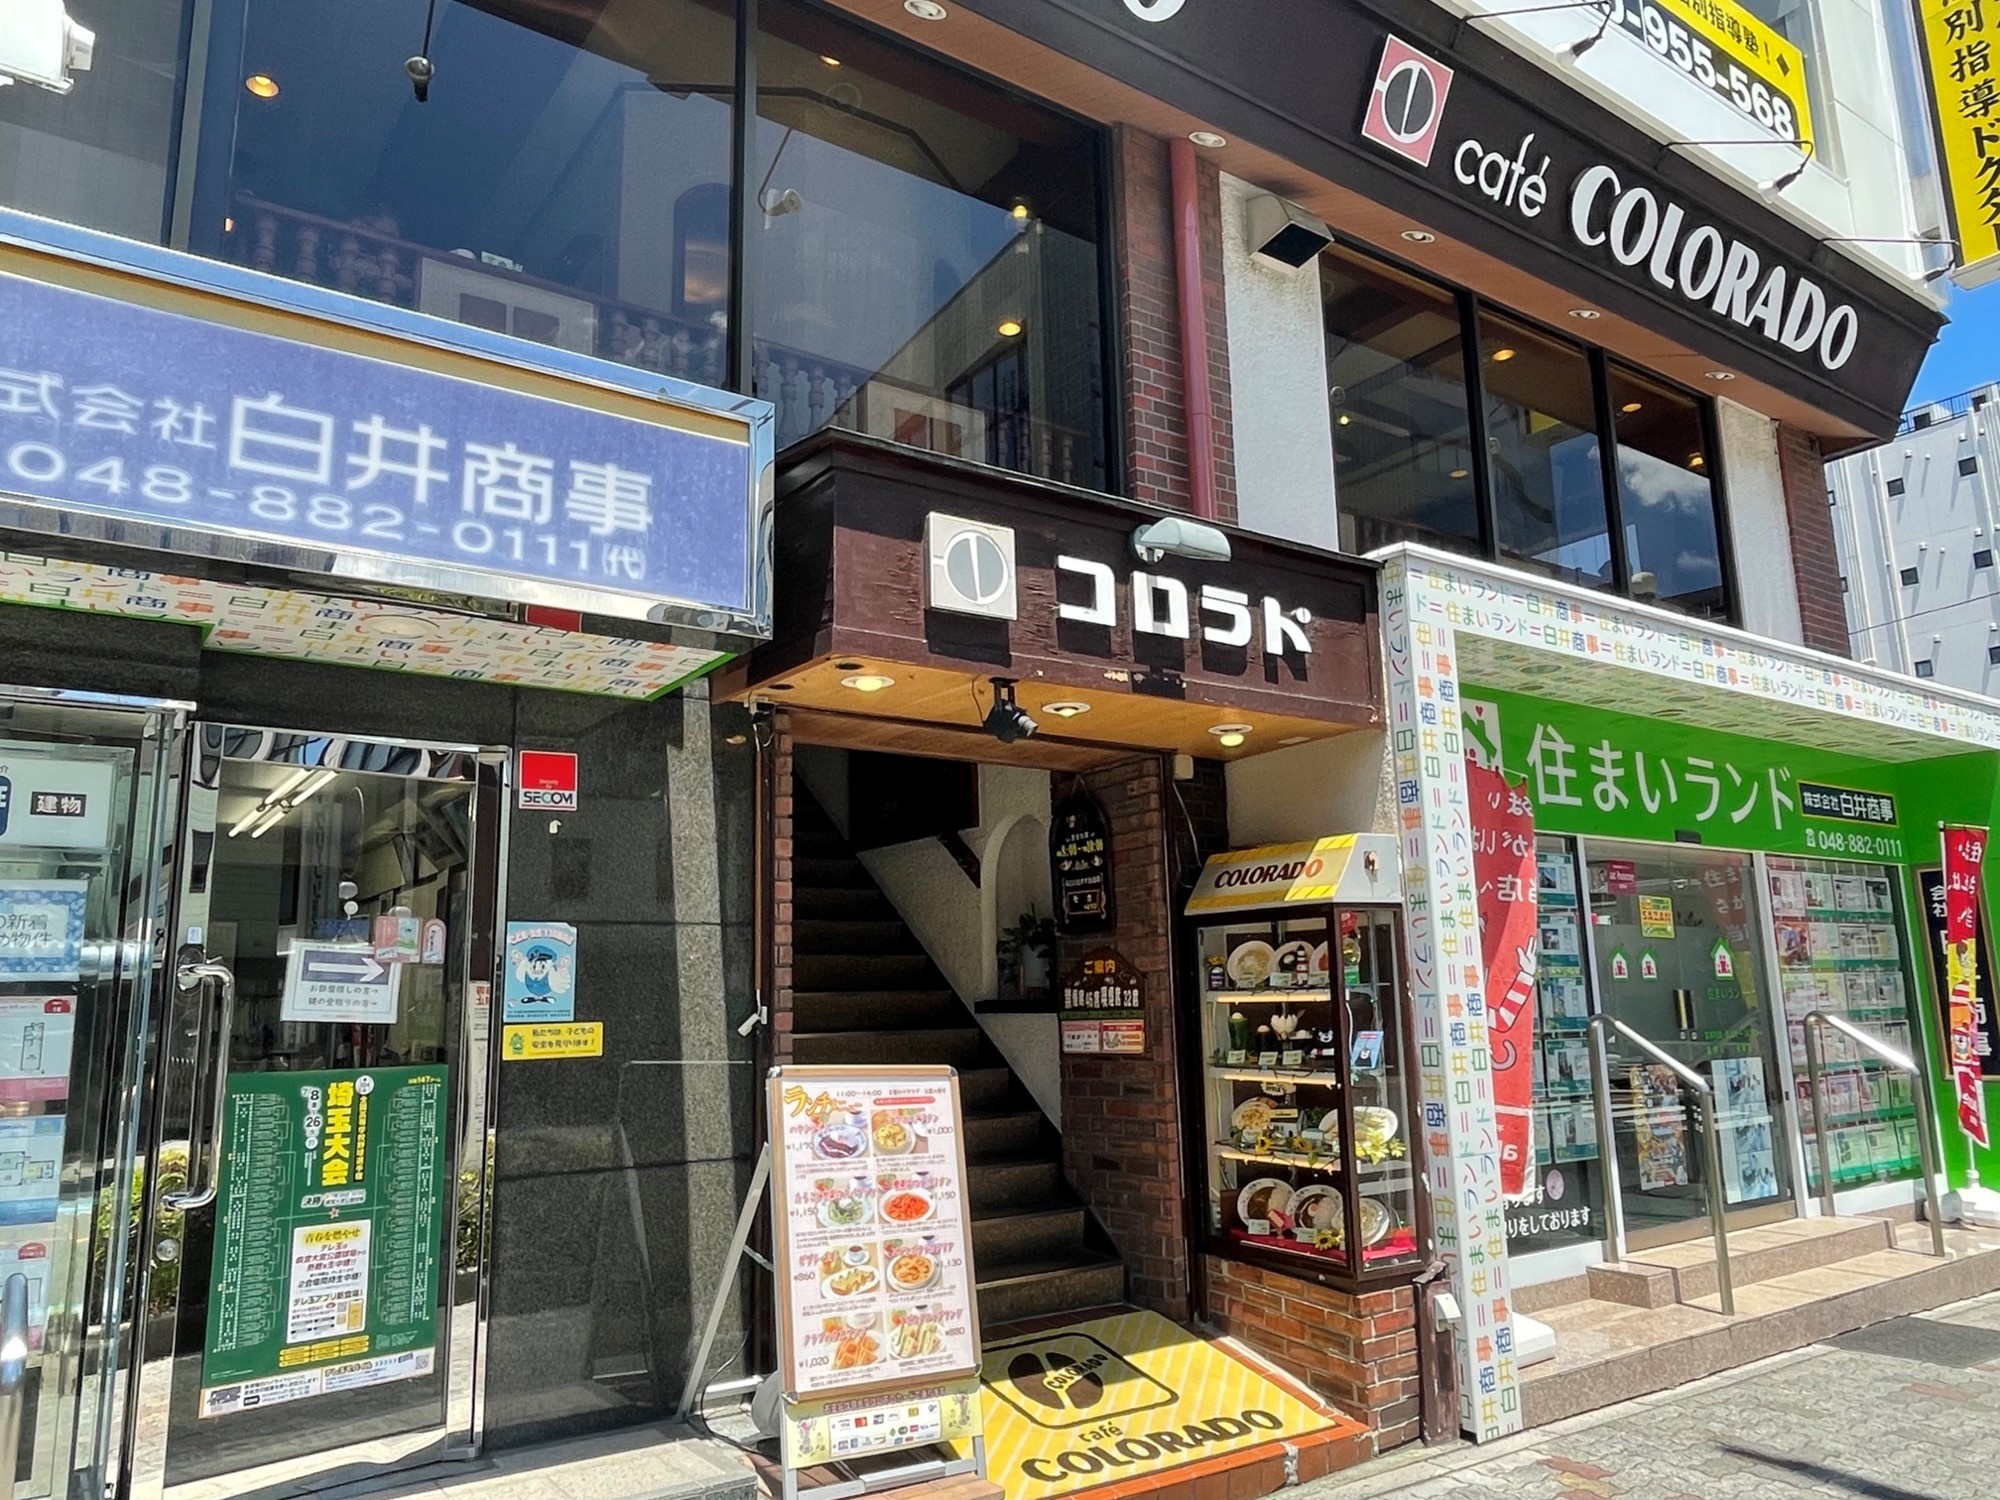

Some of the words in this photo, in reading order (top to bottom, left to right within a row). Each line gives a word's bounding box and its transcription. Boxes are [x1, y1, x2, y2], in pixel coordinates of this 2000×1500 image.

[1941, 0, 2000, 250] 別指導ドクター
[1454, 132, 1550, 219] café
[1571, 165, 1859, 371] COLORADO
[8, 445, 591, 573] 048-882-0111
[1057, 554, 1313, 656] コロラド
[1526, 723, 1795, 830] 住まいランド
[36, 795, 82, 814] 建物
[523, 791, 574, 805] SECOM
[1818, 830, 1903, 858] 048-882-0111
[1214, 858, 1324, 889] COLORADO
[306, 1116, 321, 1128] 26
[321, 1081, 354, 1187] 埼玉大会
[1504, 1205, 1591, 1239] りをしております
[1046, 1353, 1109, 1390] COLORADO
[1021, 1409, 1284, 1482] COLORADO
[1078, 1421, 1124, 1442] café
